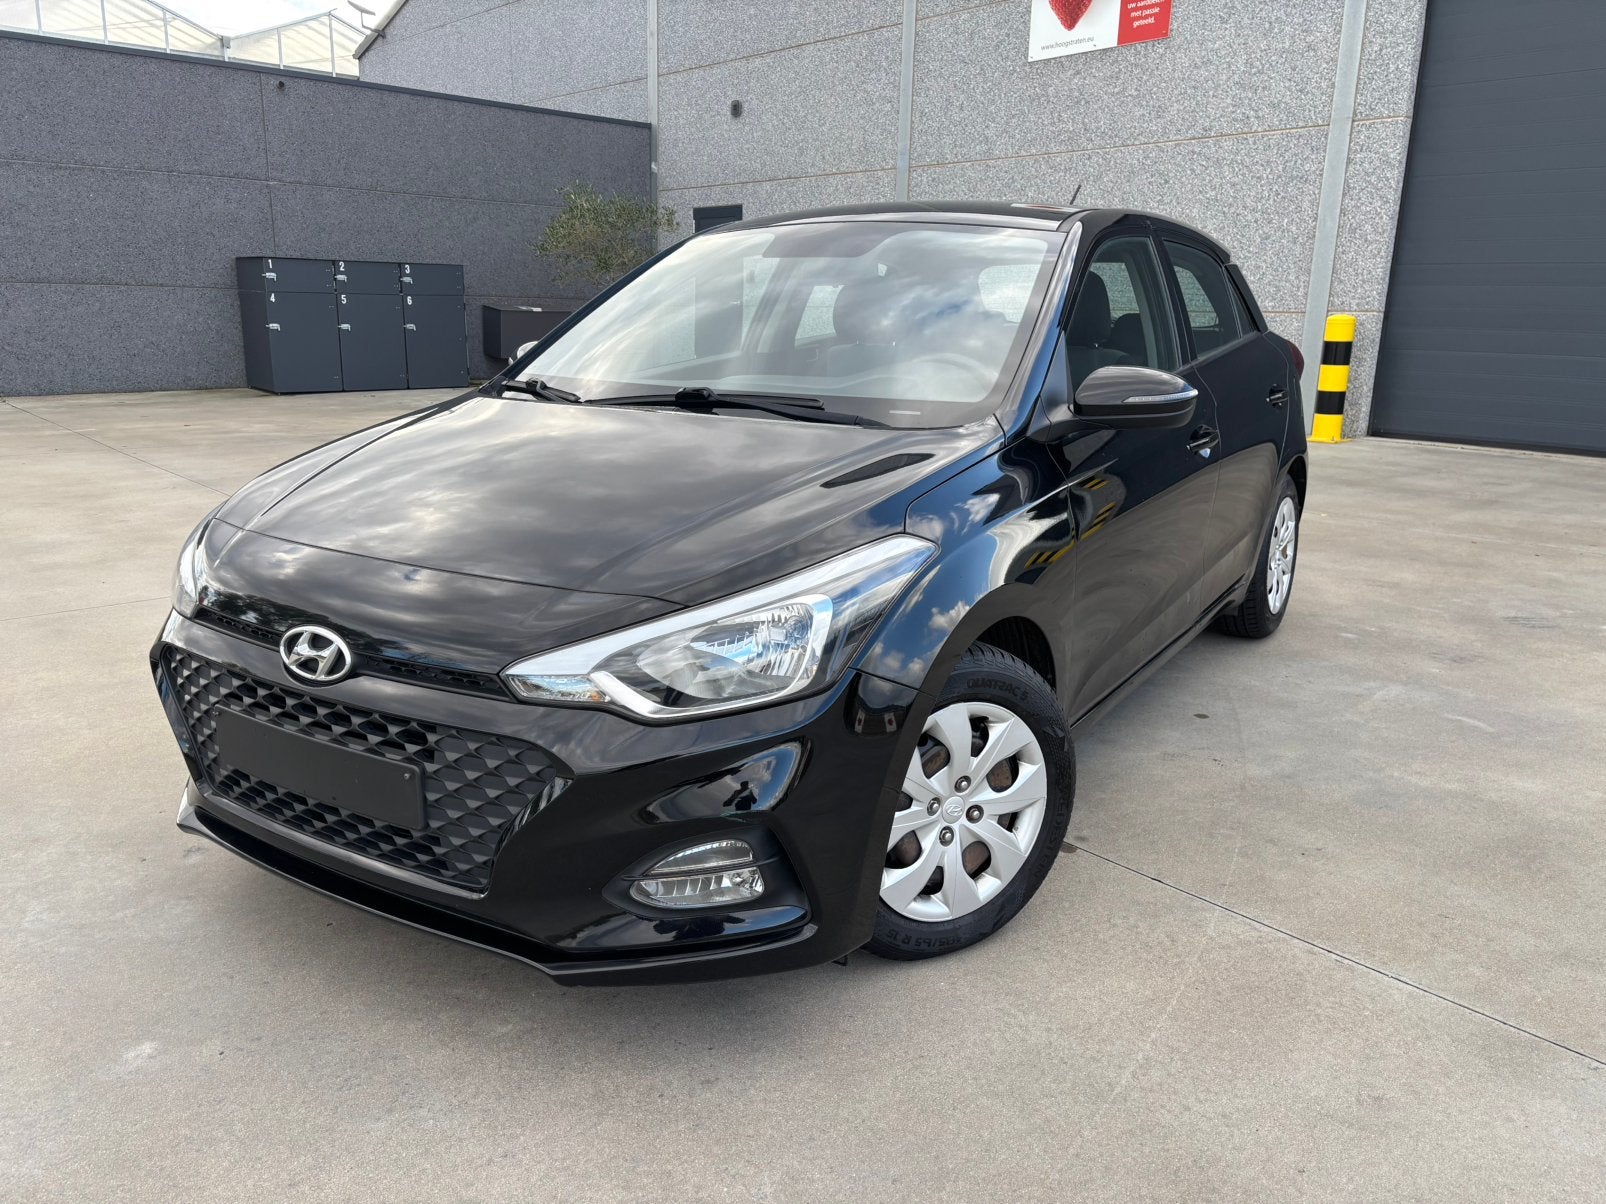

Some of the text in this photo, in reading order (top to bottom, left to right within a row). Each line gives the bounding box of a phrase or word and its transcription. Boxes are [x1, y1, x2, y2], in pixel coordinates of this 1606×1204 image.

[1040, 36, 1095, 51] www.hoogstraten.eu
[268, 259, 411, 274] 1 2 3
[270, 293, 413, 305] 4 5 6
